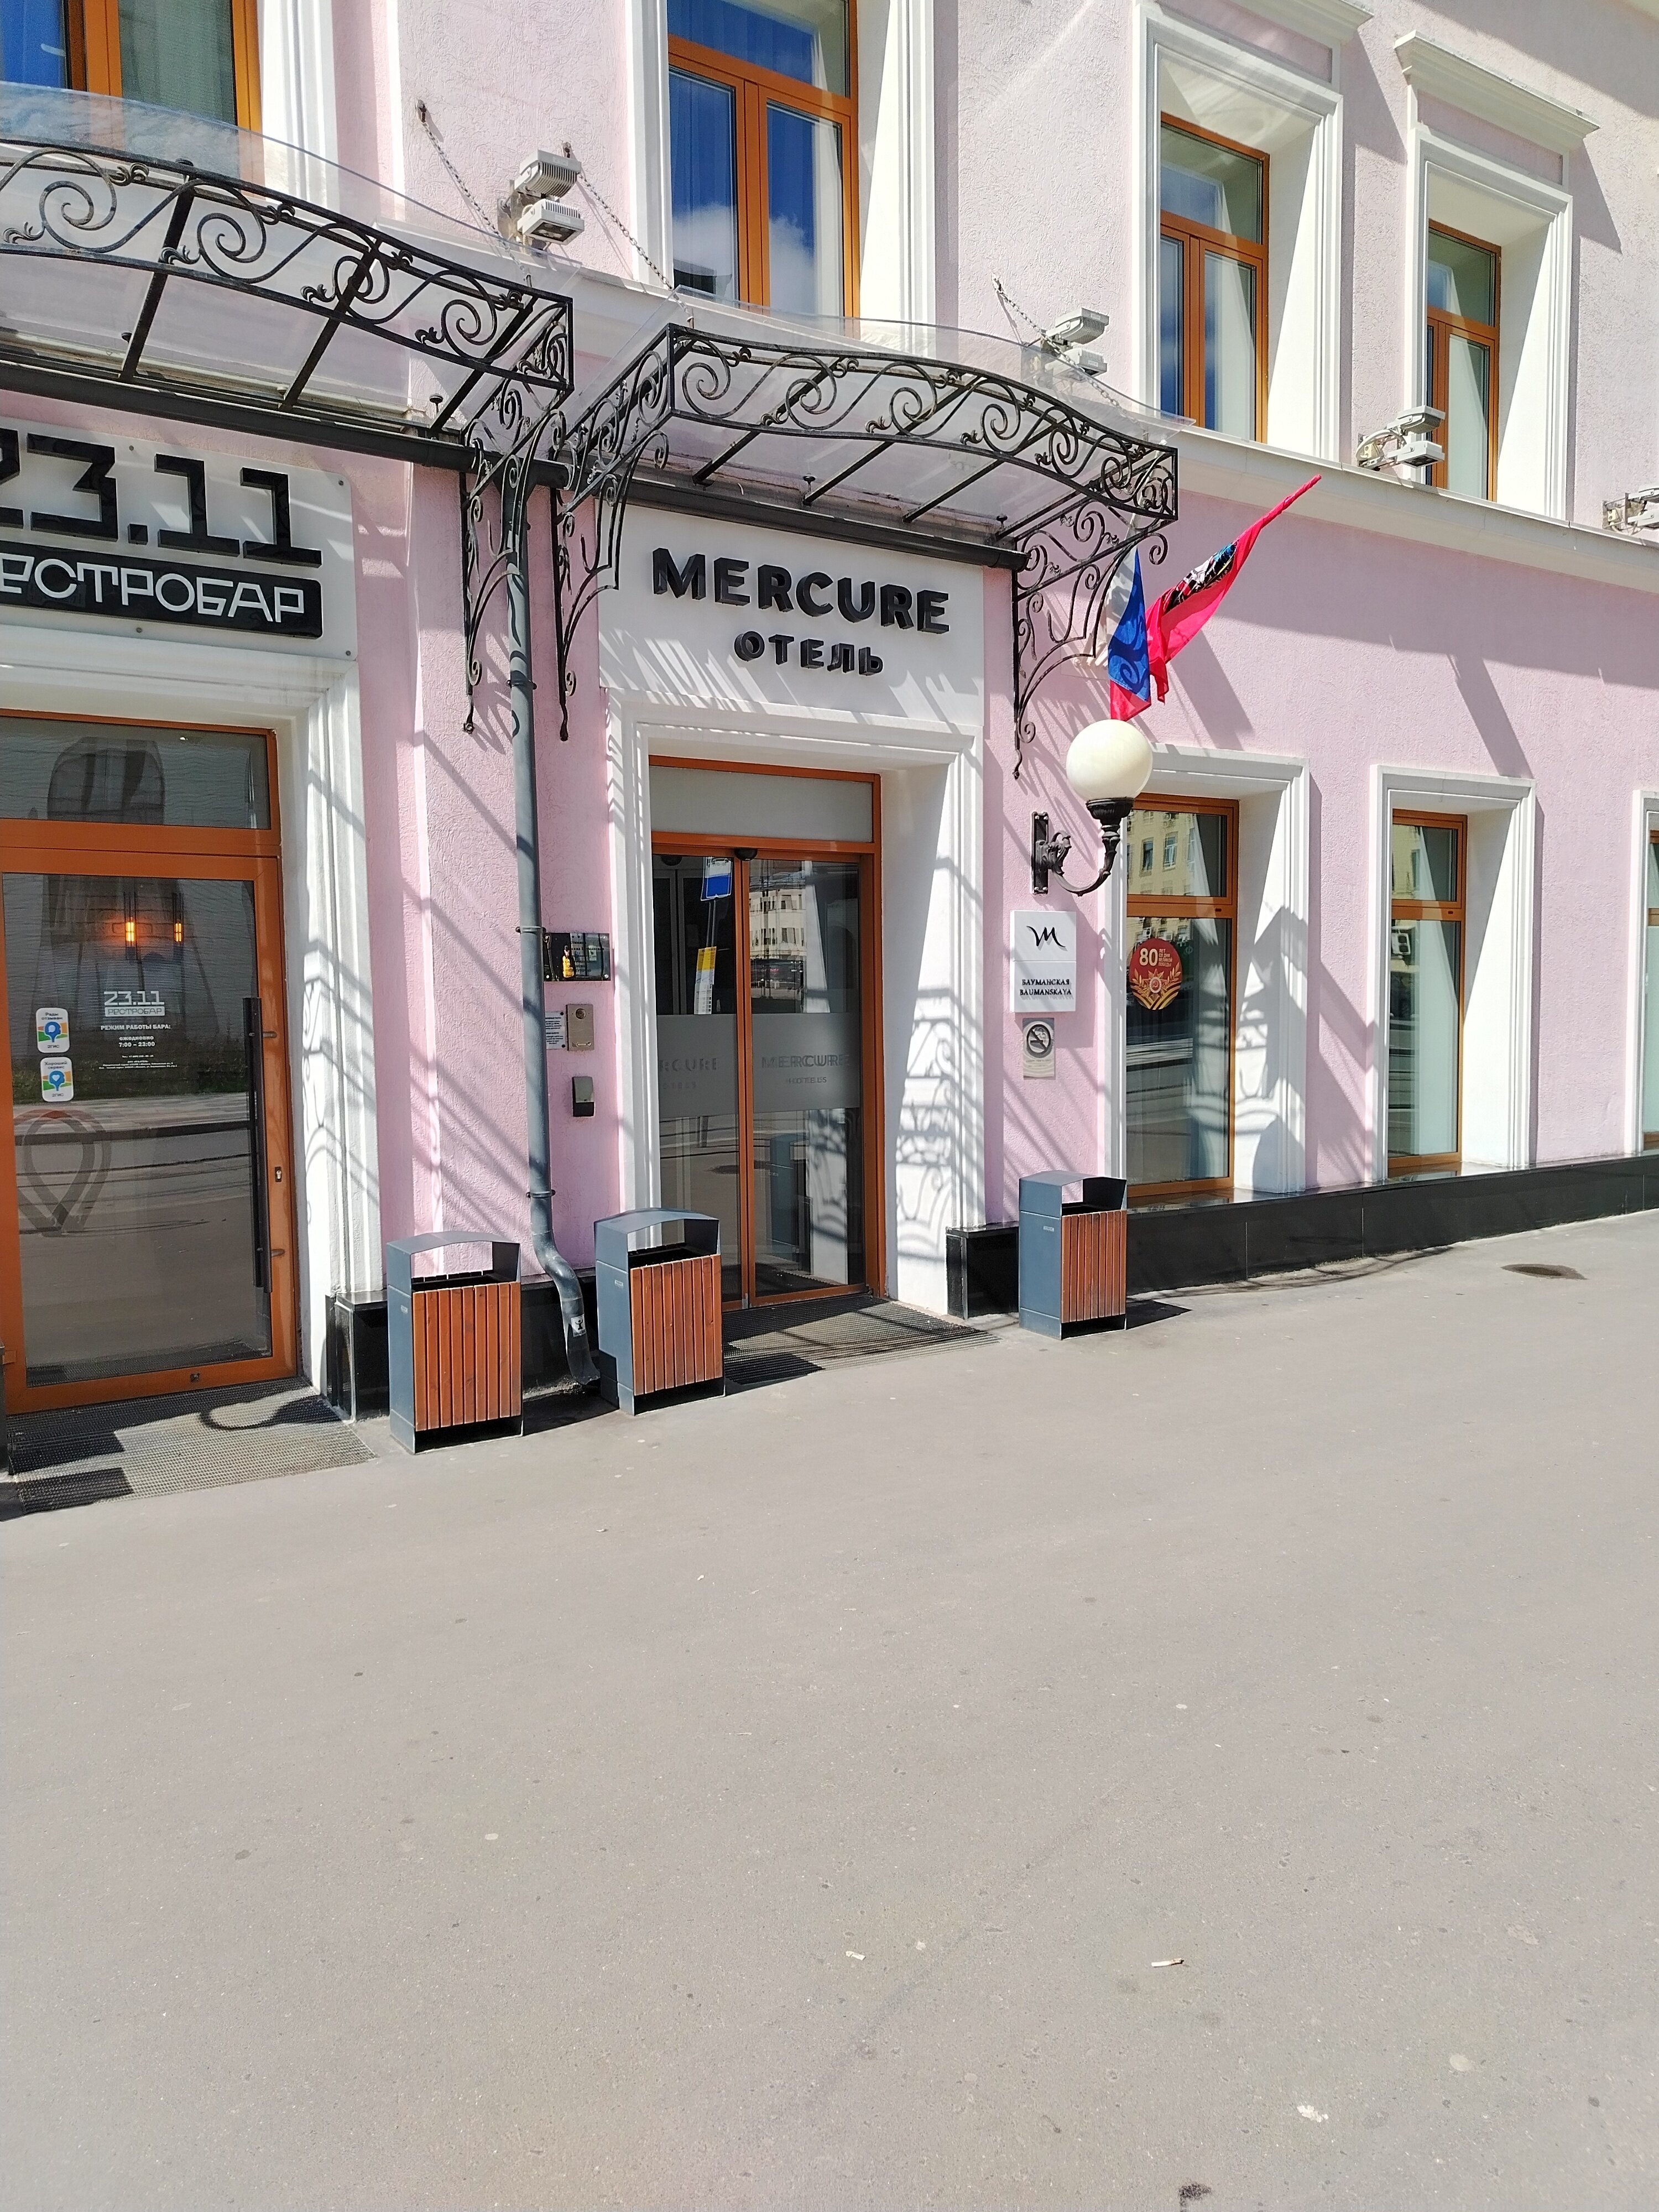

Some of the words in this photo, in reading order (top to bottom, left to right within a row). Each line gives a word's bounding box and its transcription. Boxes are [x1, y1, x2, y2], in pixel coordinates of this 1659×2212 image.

[0, 428, 322, 568] 3.11
[653, 547, 950, 634] MERCURE
[734, 630, 884, 676] ОТЕЛЬ
[1139, 948, 1158, 966] 80
[103, 990, 165, 1005] 23.11
